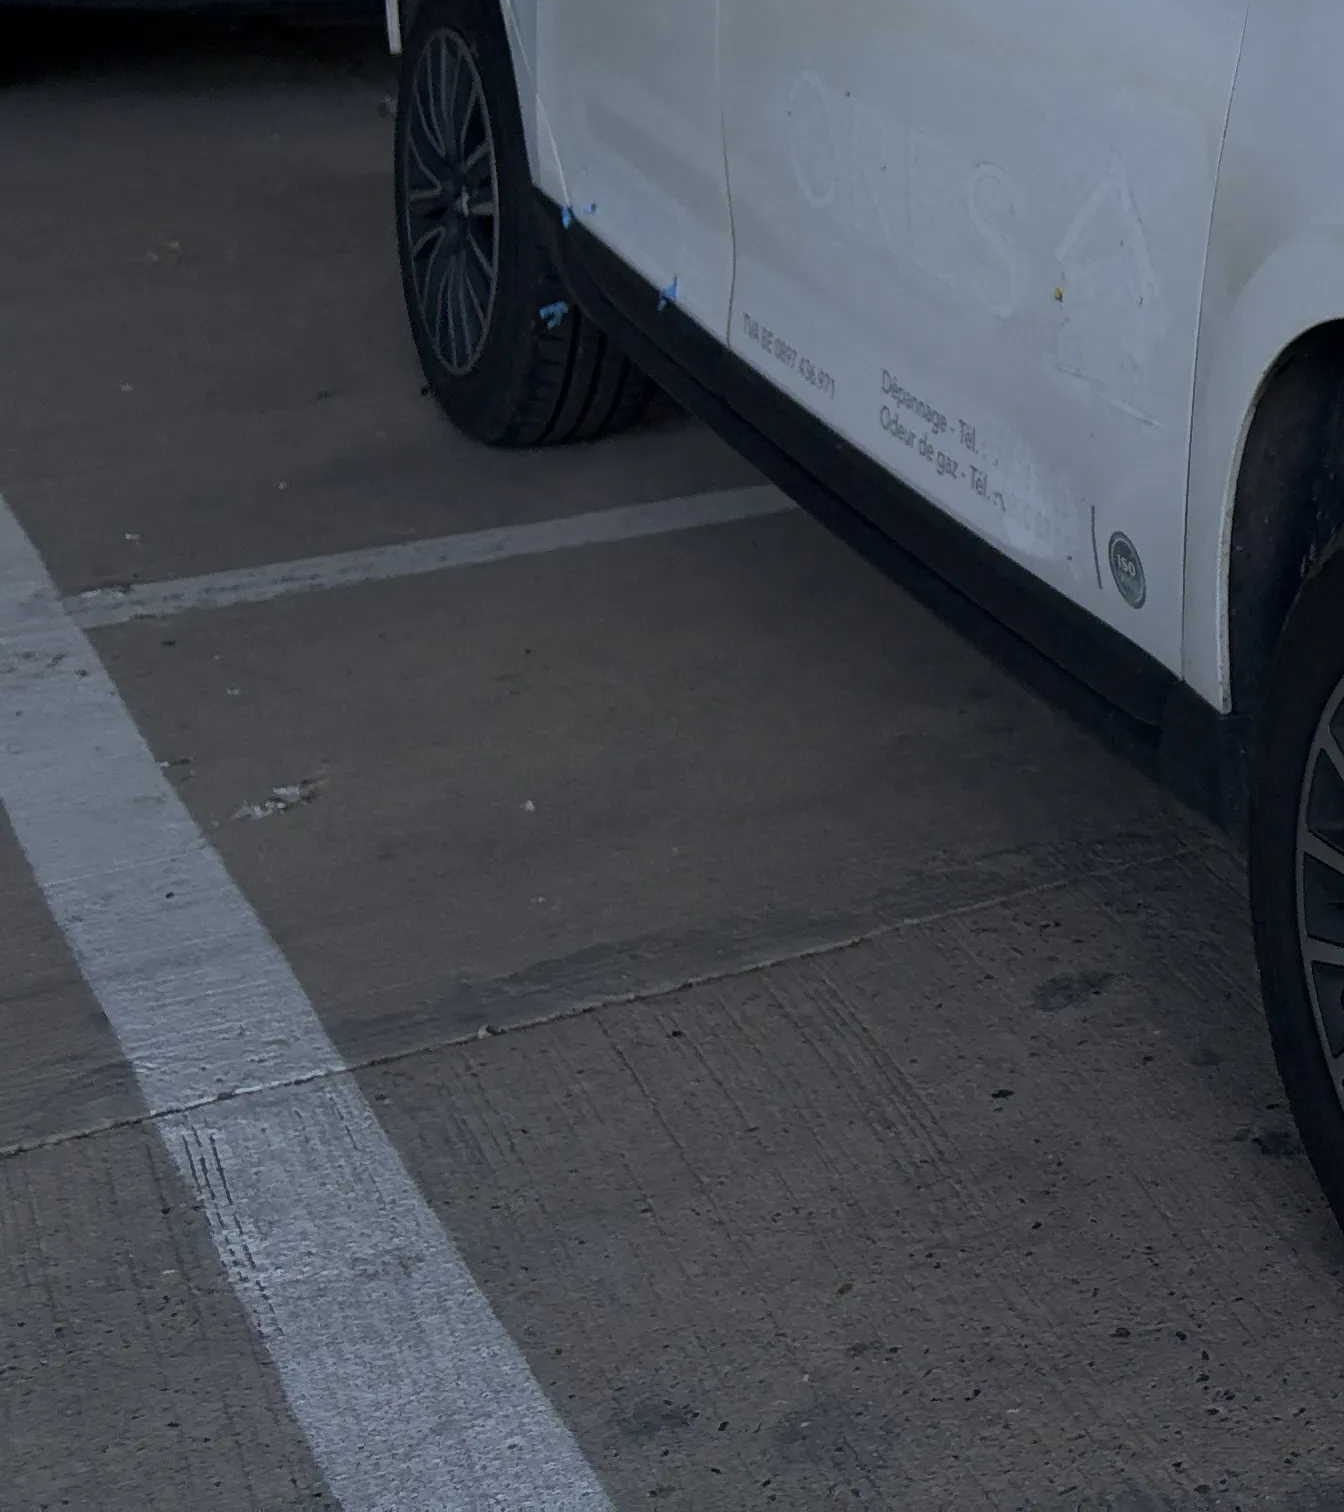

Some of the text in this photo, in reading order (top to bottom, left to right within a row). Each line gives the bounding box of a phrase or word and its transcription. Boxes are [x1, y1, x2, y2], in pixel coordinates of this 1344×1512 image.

[880, 368, 948, 434] Dépannage
[879, 405, 917, 448] Odeur
[918, 433, 935, 461] de
[936, 450, 959, 479] gaz
[1115, 554, 1137, 577] ISO
